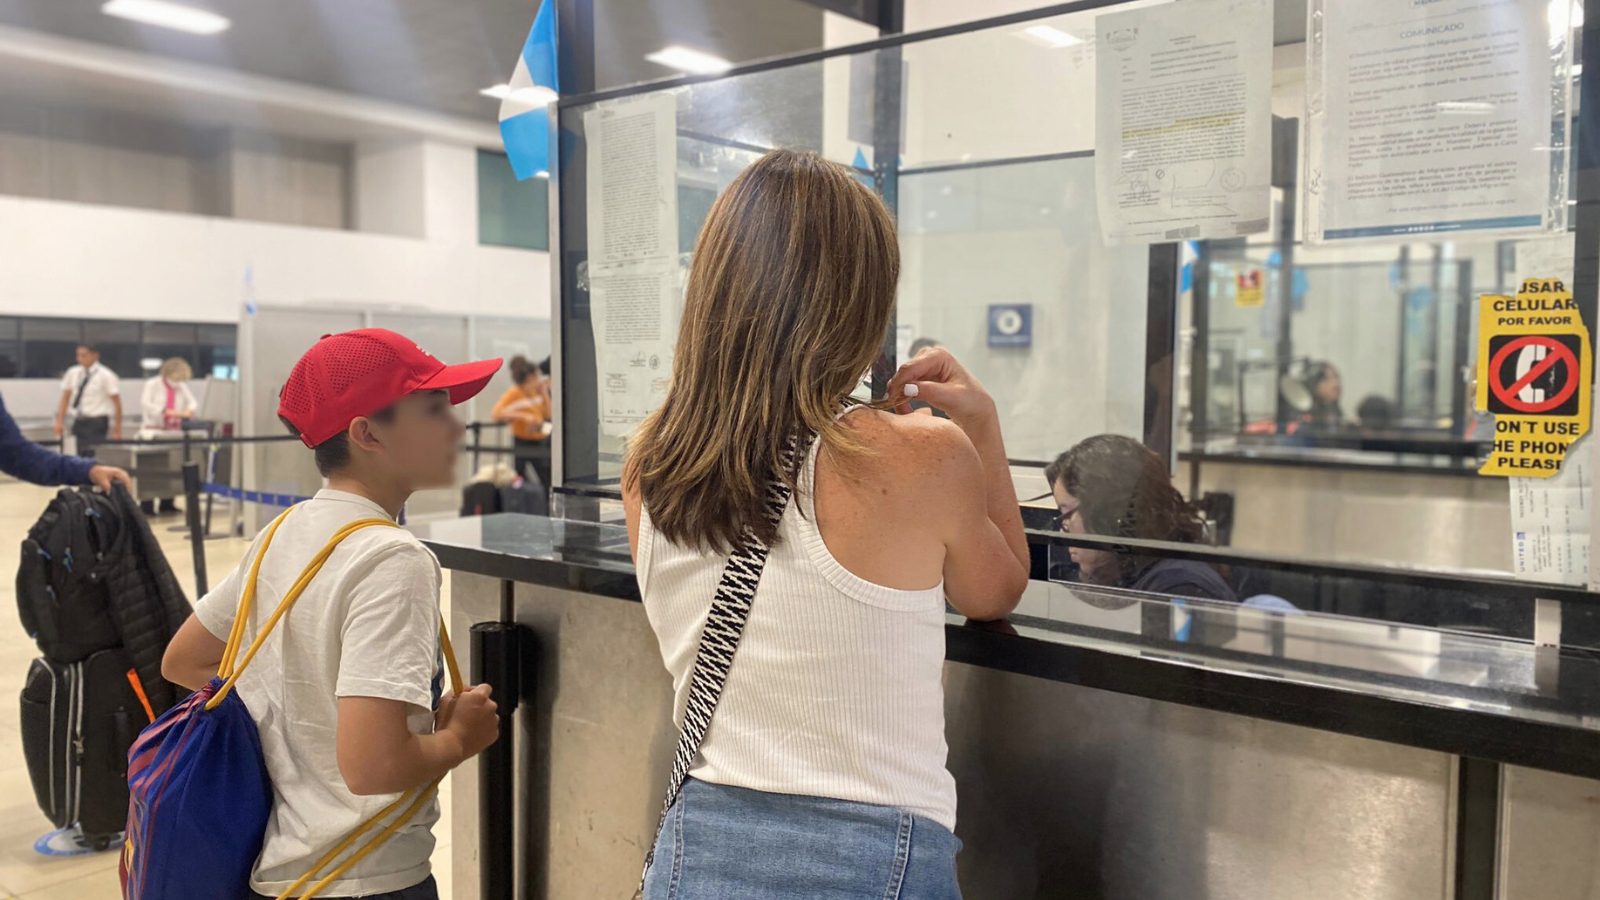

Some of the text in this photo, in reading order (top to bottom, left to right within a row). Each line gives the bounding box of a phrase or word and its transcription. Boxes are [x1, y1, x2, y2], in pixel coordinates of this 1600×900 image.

[1400, 22, 1465, 39] COMUNICADO
[1493, 299, 1578, 311] CELULAR
[1498, 316, 1572, 326] POR FAVOR
[1496, 420, 1579, 435] ON'T USE
[1492, 440, 1568, 455] HE PHON
